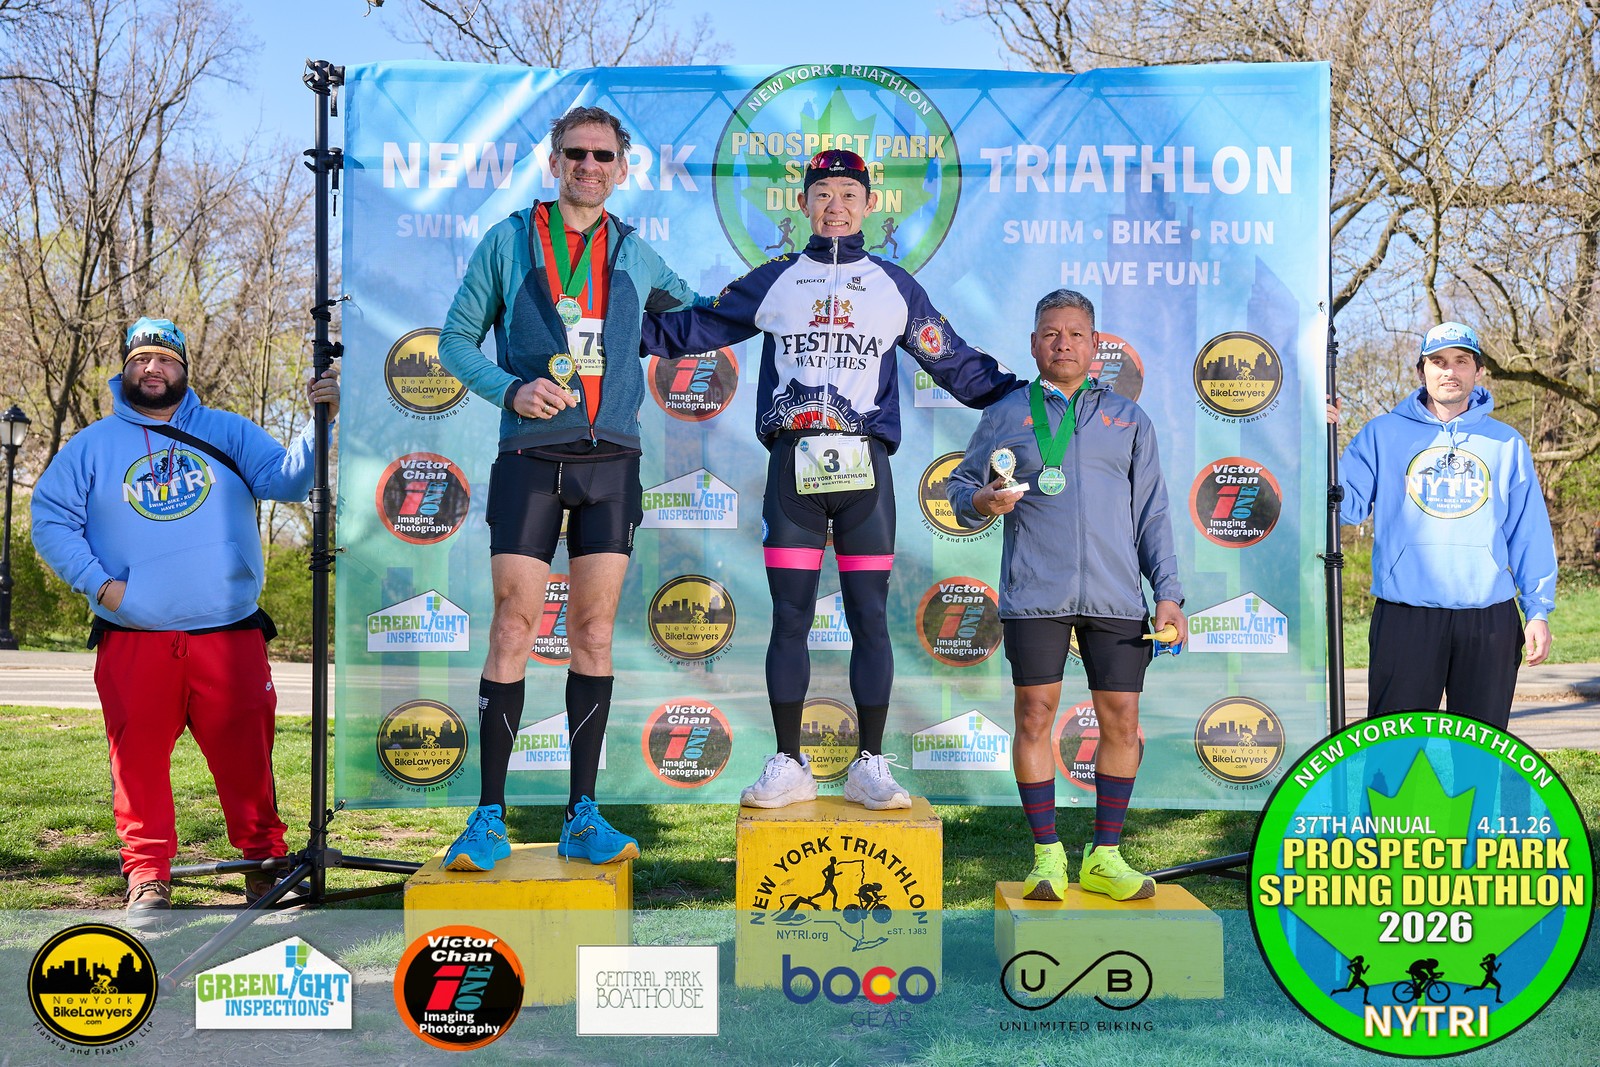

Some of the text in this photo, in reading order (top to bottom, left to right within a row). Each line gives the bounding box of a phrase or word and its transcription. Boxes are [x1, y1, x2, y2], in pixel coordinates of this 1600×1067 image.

[747, 64, 932, 116] NEW YORK TRIATHLON
[876, 135, 946, 159] PARK
[383, 141, 1292, 195] NEW YRK TRIATHLON
[396, 214, 478, 238] SWIM
[627, 217, 670, 241] UN
[1002, 220, 1274, 245] SWIM BIKE RUN
[1060, 261, 1222, 286] HAVE FUN!
[816, 316, 847, 324] FESINA
[796, 355, 866, 370] WATCHES
[690, 359, 718, 392] ONE
[401, 385, 456, 394] BikeLawyers
[1210, 388, 1266, 398] BikeLawyers
[668, 392, 704, 402] Imaging
[387, 396, 409, 418] Flanzig
[459, 396, 470, 410] LLP
[665, 401, 722, 410] Photography
[1196, 400, 1220, 422] Flanzig
[1269, 399, 1280, 412] LLP
[400, 459, 452, 470] Victor
[823, 448, 840, 472] 3
[1212, 464, 1263, 474] Victor
[402, 470, 448, 480] Chan
[1215, 474, 1258, 484] Chan
[122, 465, 216, 502] NYTRI
[1405, 475, 1493, 499] NYTRI
[183, 492, 196, 500] RUN
[419, 481, 448, 515] ONE
[1232, 485, 1260, 518] ONE
[161, 504, 176, 512] HAVE
[397, 515, 434, 524] Imaging
[1210, 519, 1246, 528] Imaging
[394, 524, 452, 534] Photography
[921, 518, 944, 540] Flanzig
[992, 518, 1003, 532] LLP
[1207, 527, 1264, 537] Photography
[939, 583, 988, 594] Victor
[941, 594, 984, 604] Chan
[958, 605, 986, 638] ONE
[535, 636, 568, 646] maging
[665, 632, 719, 641] BikeLawyers
[936, 638, 972, 648] Imaging
[933, 646, 989, 656] Photography
[665, 704, 714, 714] Victor
[668, 715, 710, 724] Chan
[683, 726, 712, 759] ONE
[394, 757, 450, 766] BikeLawyers
[526, 750, 570, 762] INSPECT
[1212, 755, 1268, 764] BikeLawyers
[663, 759, 698, 769] Imaging
[380, 769, 404, 790] Flanzig
[454, 767, 466, 780] LLP
[659, 768, 715, 778] Photography
[1198, 765, 1222, 786] Flanzig
[1272, 765, 1284, 778] LLP
[750, 836, 928, 925] NEW YORK TRIATHLON
[776, 930, 828, 941] NYTRI.org
